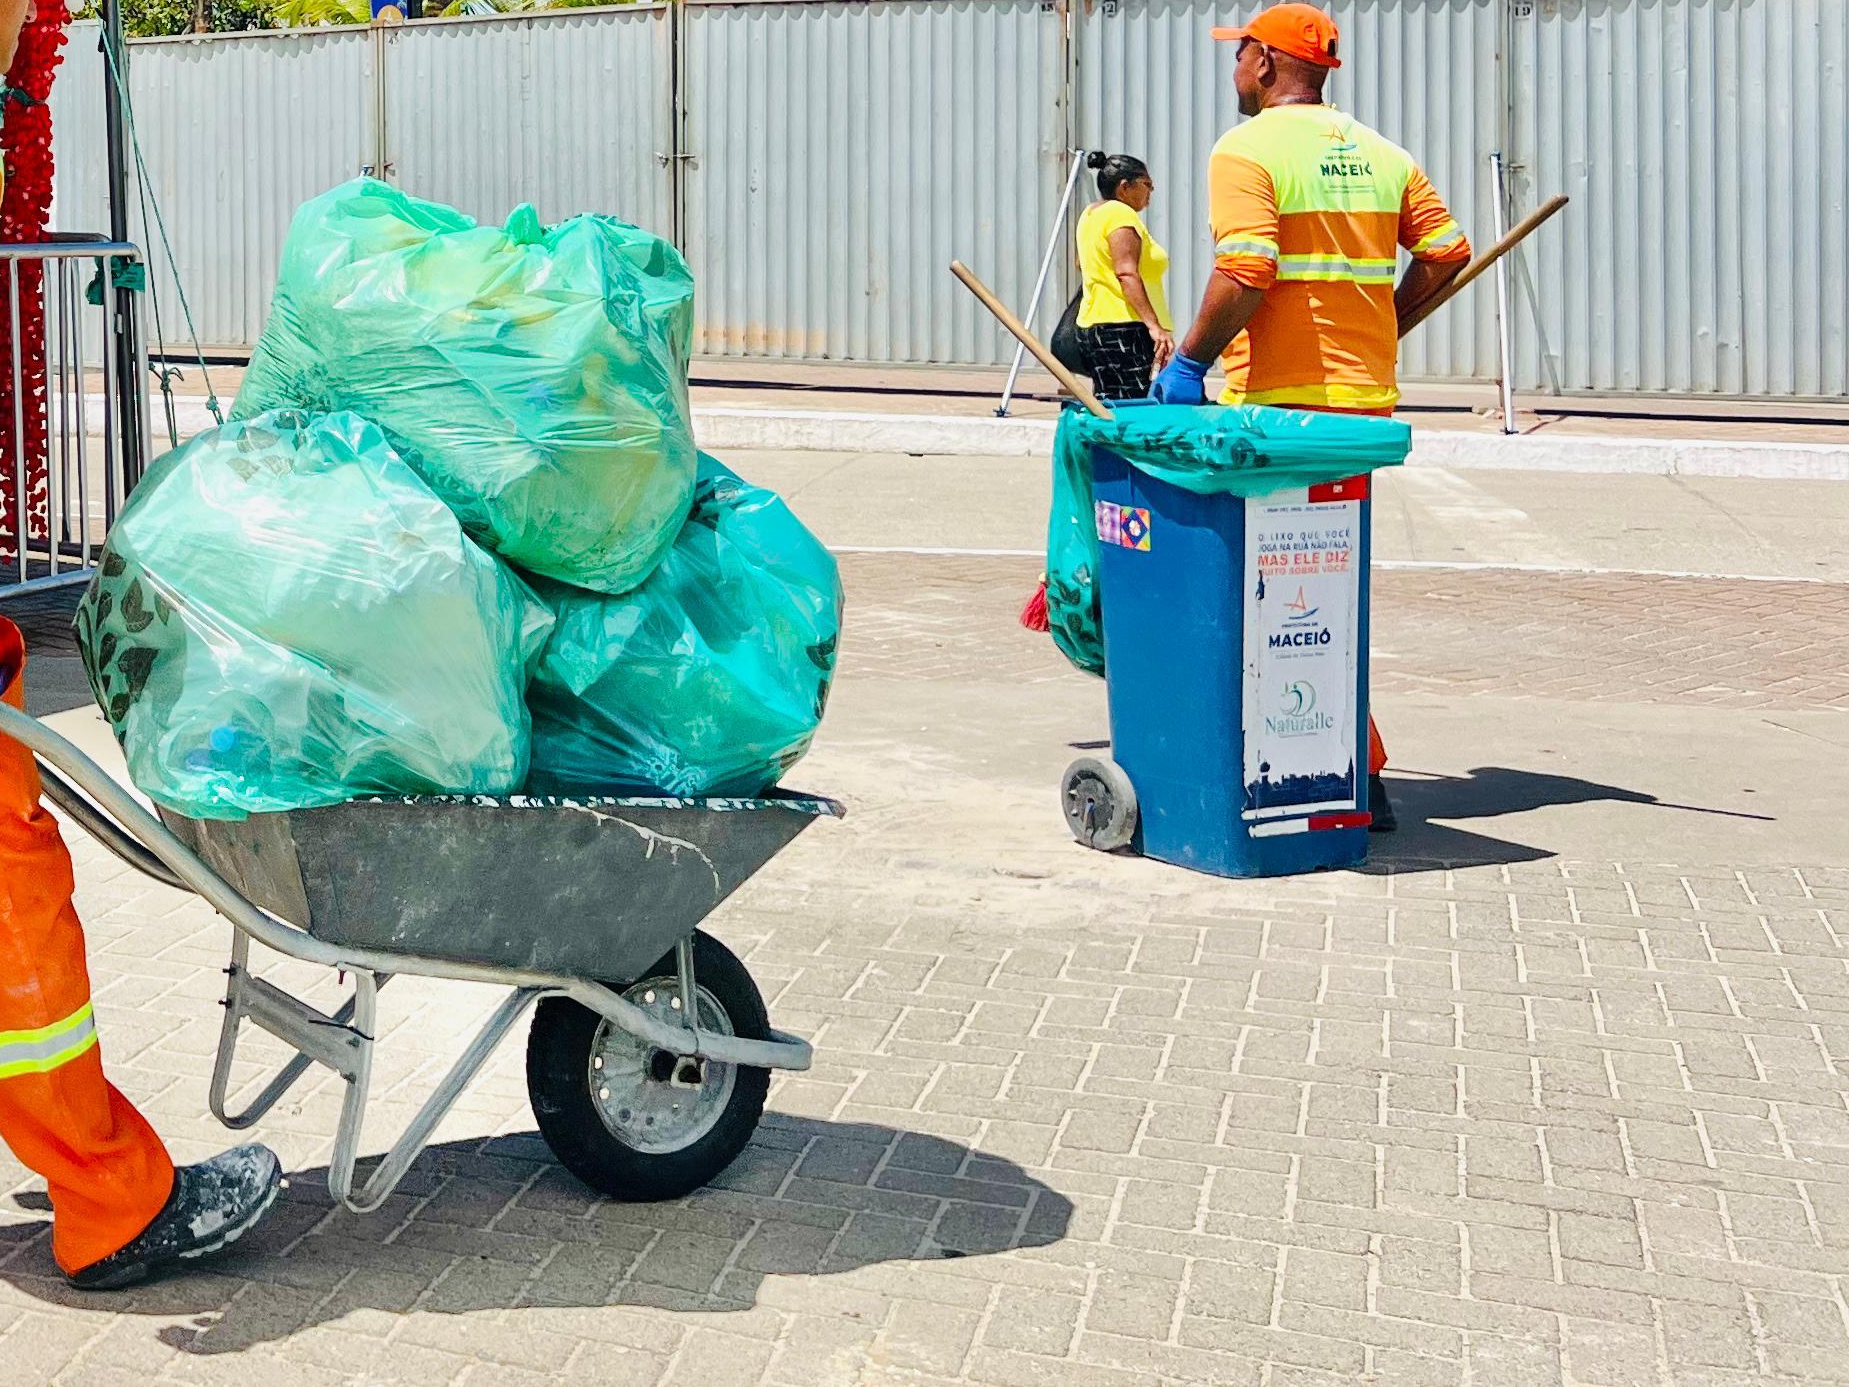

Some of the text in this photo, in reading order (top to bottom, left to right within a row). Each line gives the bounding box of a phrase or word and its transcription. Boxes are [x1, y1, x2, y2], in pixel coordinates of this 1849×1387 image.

[1258, 550, 1350, 566] MAS ELE DIZ
[1268, 627, 1331, 649] MACEIÓ
[1265, 712, 1334, 735] Naturalle
